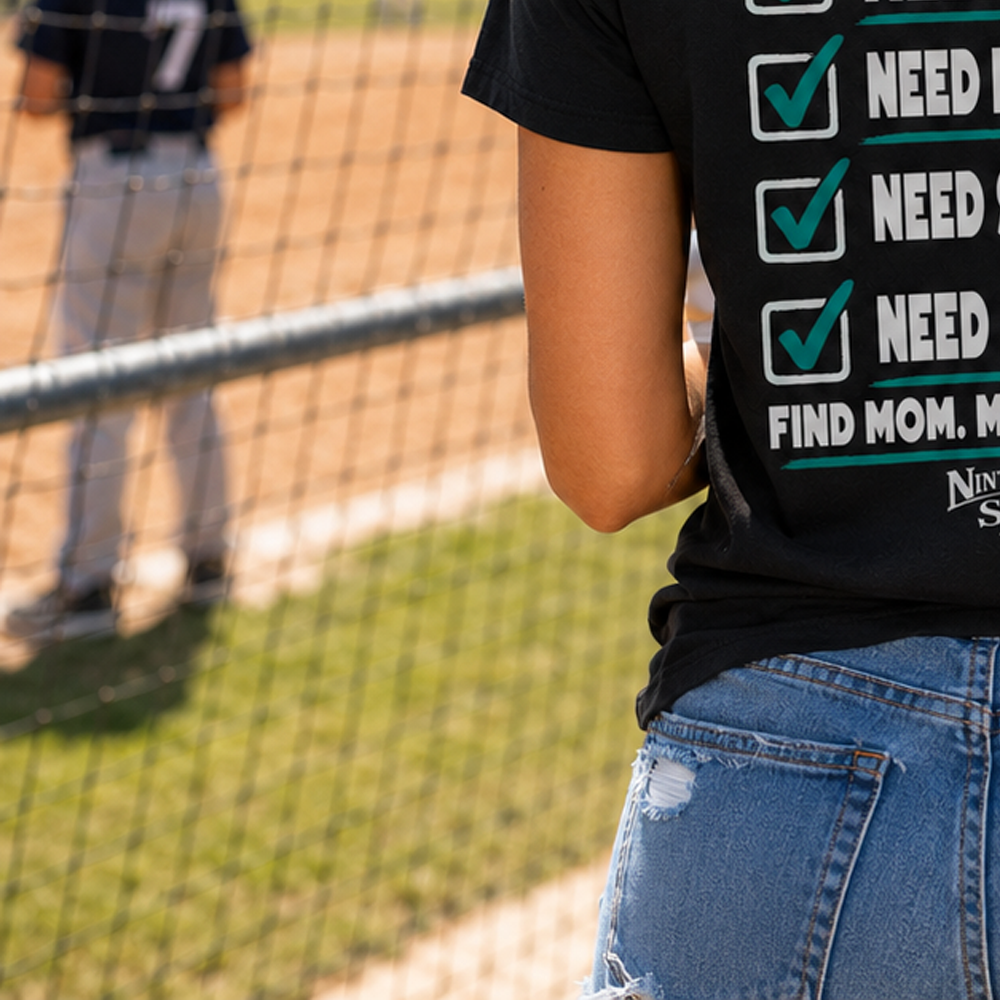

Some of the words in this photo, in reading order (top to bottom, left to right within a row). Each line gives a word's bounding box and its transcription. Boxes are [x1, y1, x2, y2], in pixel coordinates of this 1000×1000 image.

[867, 47, 980, 118] NEED
[872, 170, 985, 242] NEED
[877, 291, 990, 363] NEED
[769, 402, 856, 449] FIND
[865, 396, 967, 444] MOM.
